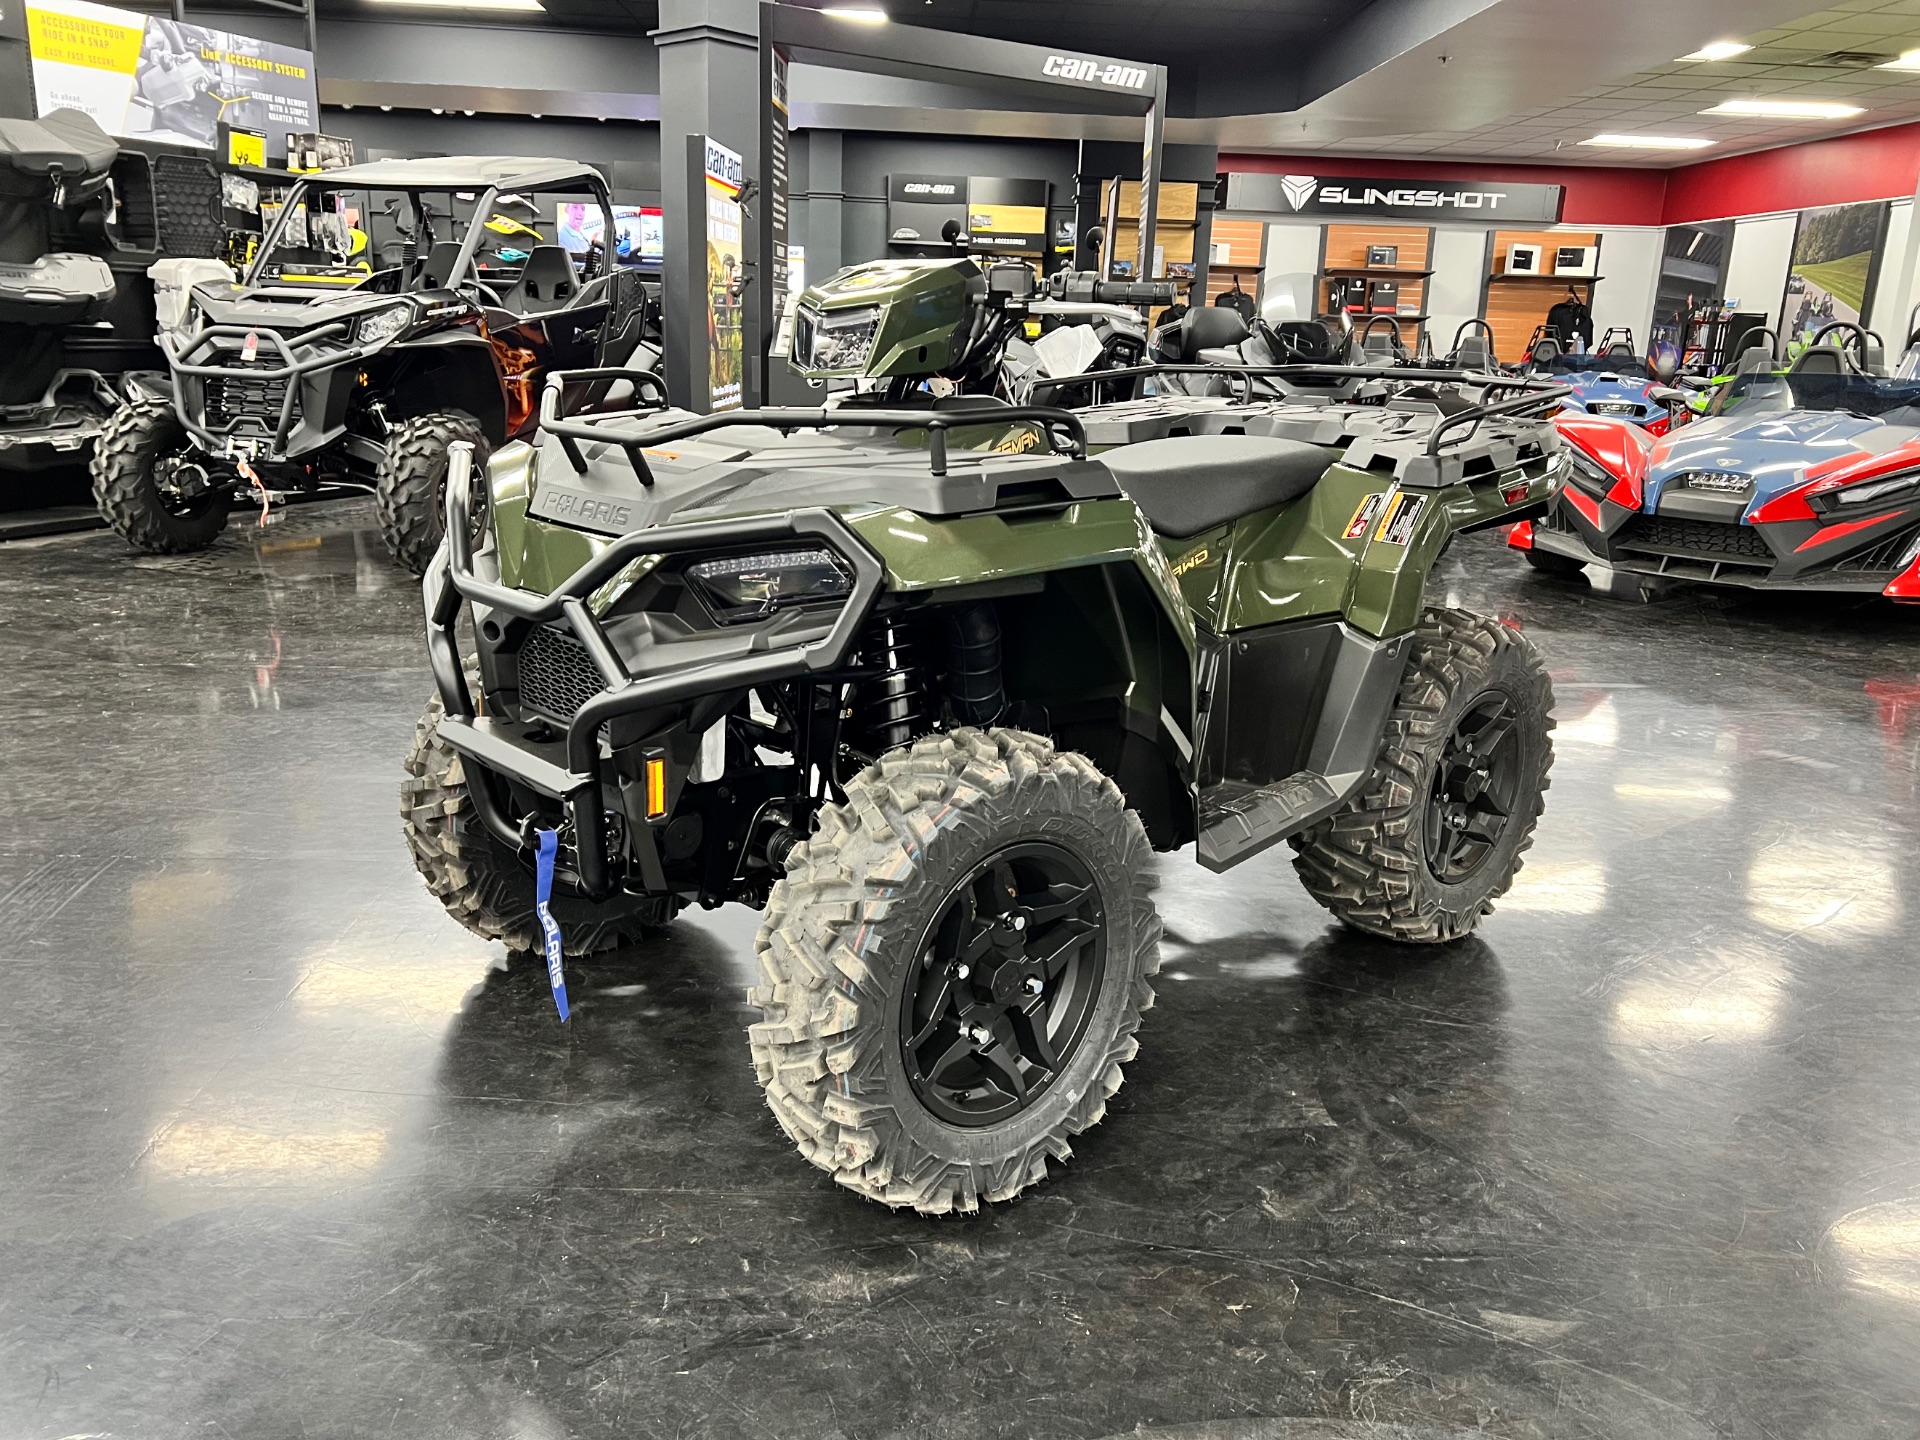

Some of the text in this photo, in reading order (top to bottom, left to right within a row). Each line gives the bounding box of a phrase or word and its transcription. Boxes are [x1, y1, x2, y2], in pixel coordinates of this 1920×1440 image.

[41, 15, 125, 41] ACCESSORIZE YOUR
[42, 28, 110, 49] RIDE IN A SNAP
[44, 47, 64, 58] EASY.
[225, 53, 273, 73] ACCESSORY
[274, 63, 306, 79] SYSTEM
[1042, 55, 1148, 89] can-am
[50, 91, 59, 99] Go
[251, 91, 309, 109] SECURE AND REMOVE
[268, 104, 284, 113] WITH
[289, 107, 309, 118] SIMPLE
[268, 112, 294, 124] QUARTER
[706, 146, 742, 184] can-am
[904, 183, 956, 195] can-am
[1319, 187, 1507, 209] SLINGSHOT
[994, 238, 1027, 246] ACCESSORIES
[543, 491, 632, 528] POLARIS
[538, 900, 564, 989] POLARIS
